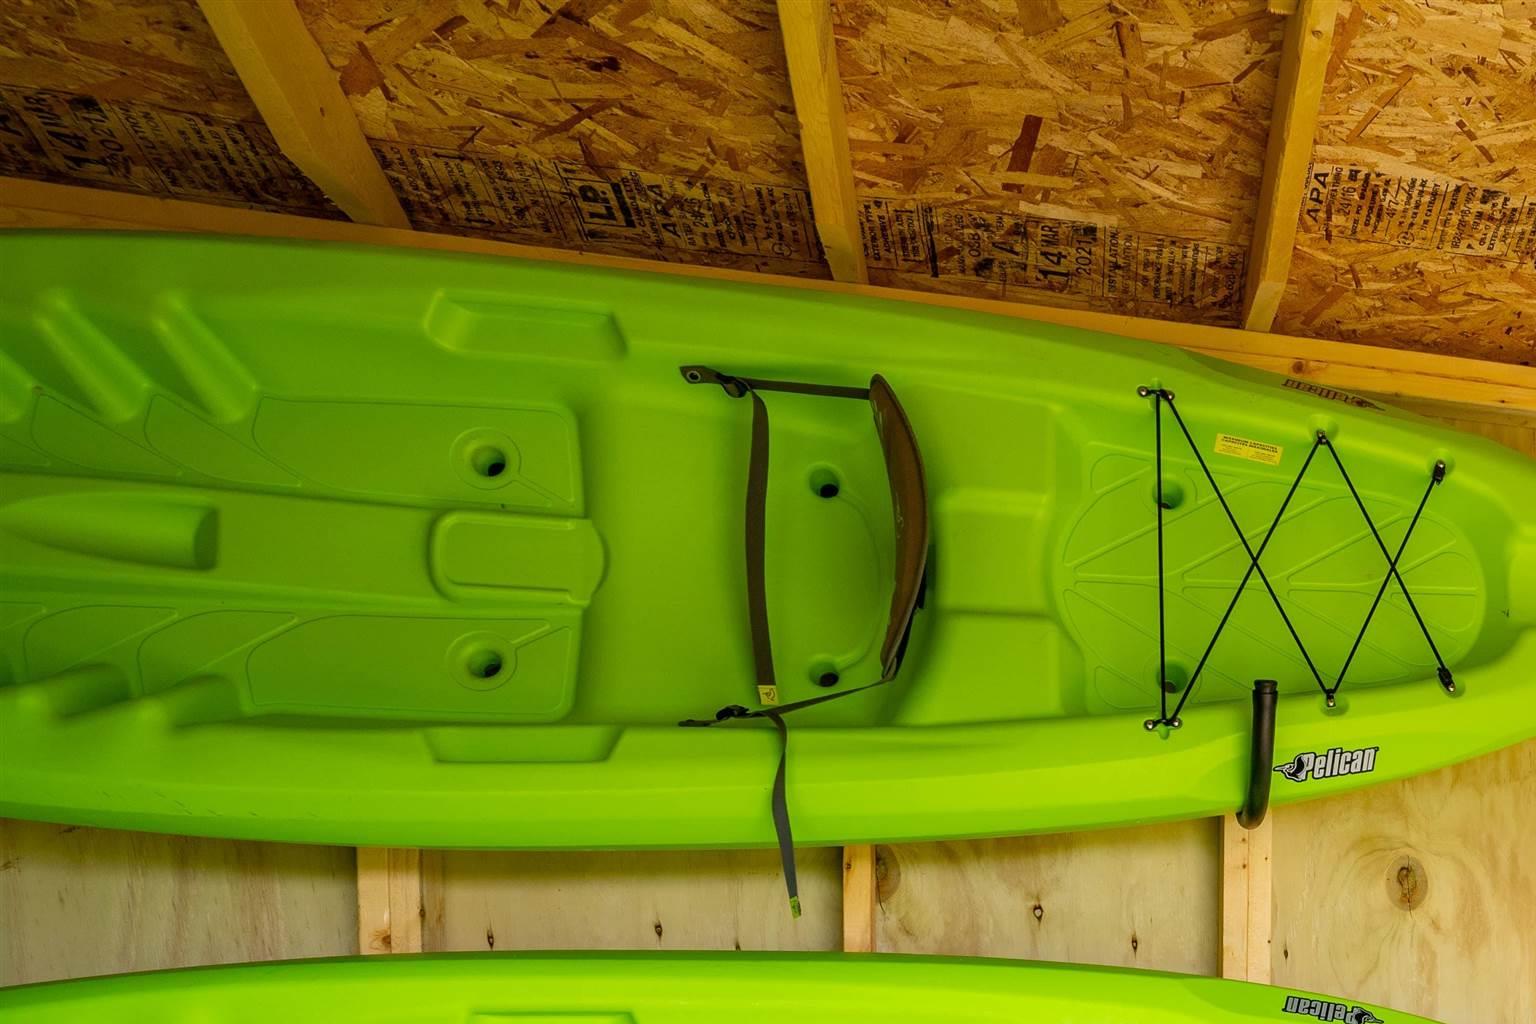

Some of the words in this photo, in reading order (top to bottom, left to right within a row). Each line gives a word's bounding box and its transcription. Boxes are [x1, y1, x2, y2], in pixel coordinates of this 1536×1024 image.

[1299, 170, 1333, 223] APA
[1036, 248, 1071, 282] 14
[1074, 237, 1091, 275] 2021
[1301, 747, 1379, 782] Pelican
